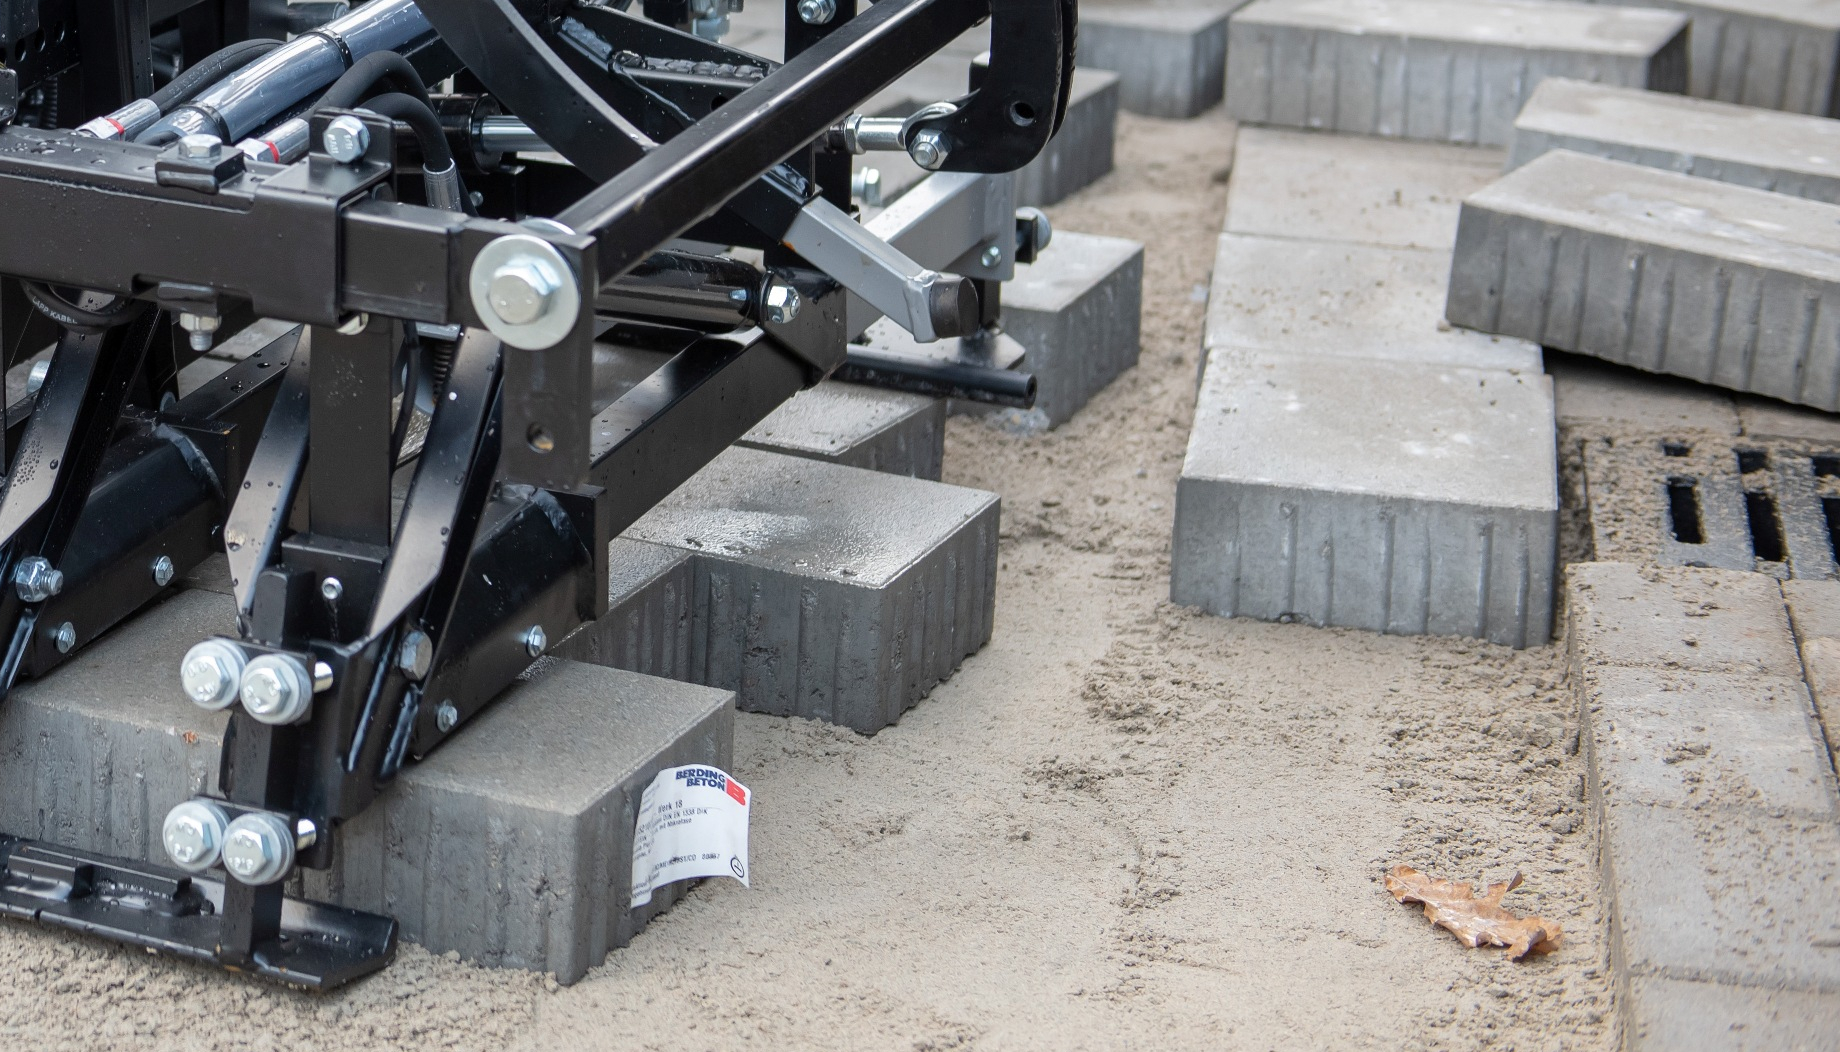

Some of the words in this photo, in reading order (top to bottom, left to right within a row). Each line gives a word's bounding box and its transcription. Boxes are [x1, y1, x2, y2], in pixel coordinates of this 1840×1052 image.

[49, 310, 78, 325] KABEL
[676, 768, 726, 783] BERDING
[686, 777, 725, 792] BETON
